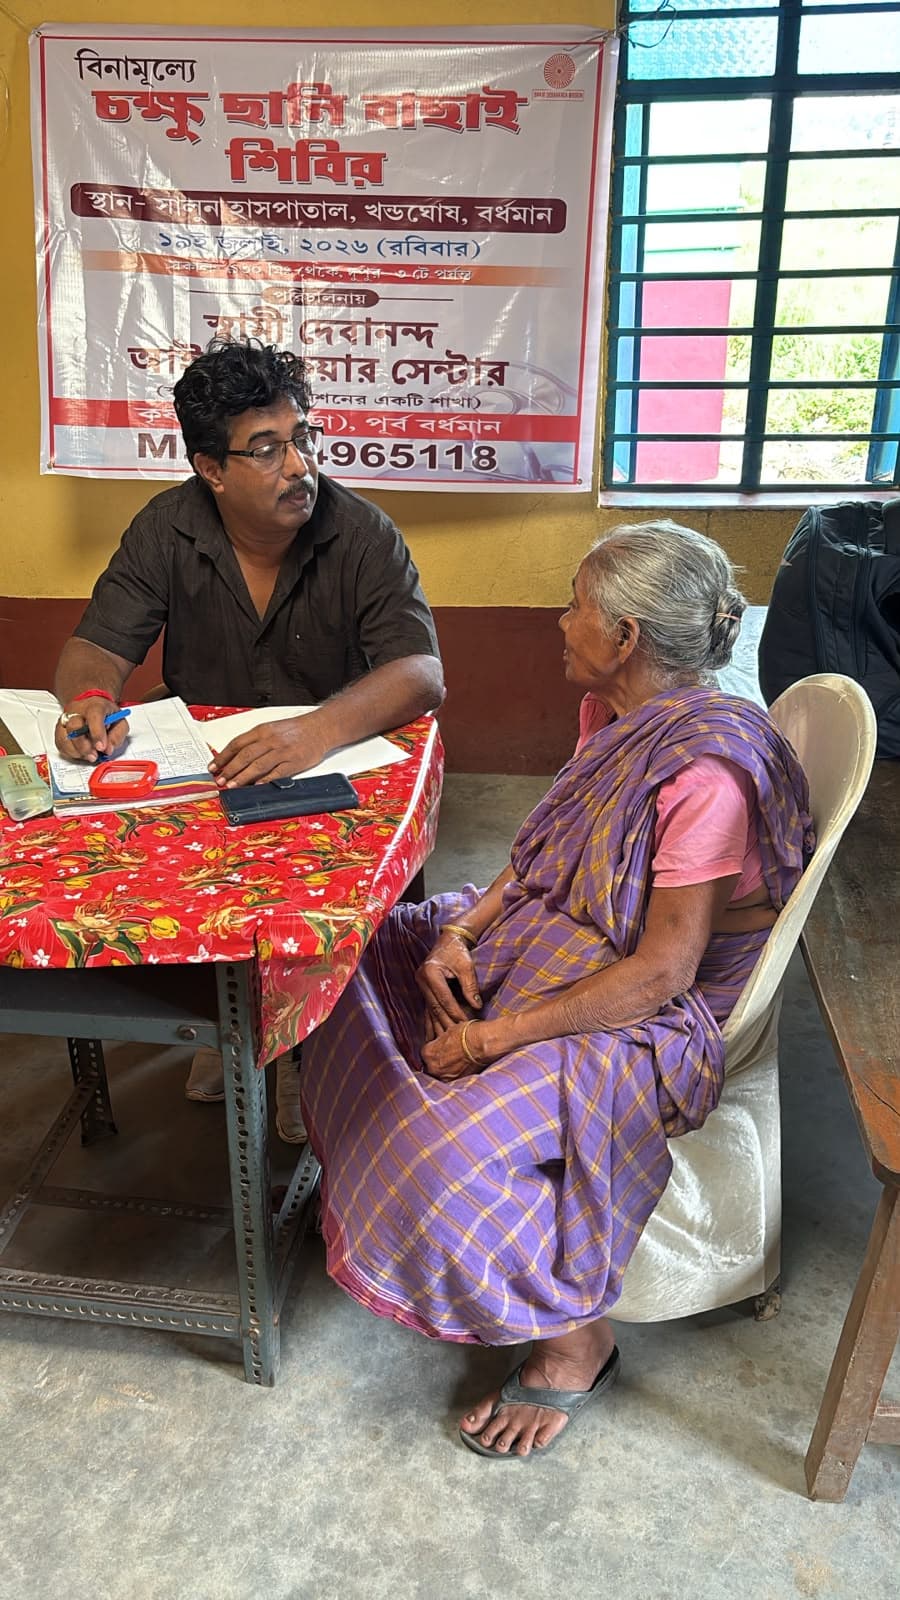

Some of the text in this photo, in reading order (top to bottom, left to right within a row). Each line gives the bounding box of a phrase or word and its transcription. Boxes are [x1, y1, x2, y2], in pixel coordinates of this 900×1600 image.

[75, 48, 197, 87] বিনামূল্যে
[91, 82, 529, 144] চক্ষু ছানি বাছাই
[224, 137, 388, 188] শিবির
[152, 196, 219, 223] সালুন
[226, 198, 356, 224] হাসপাতাল,
[365, 200, 468, 226] খন্ডঘোষ,
[474, 199, 553, 225] বর্ধমান
[159, 232, 209, 252] ১৯ই
[301, 238, 369, 255] ২০২৬
[377, 235, 481, 259] (রবিবার)
[272, 288, 367, 304] পরিচালনায়
[299, 317, 438, 349] দেবানন্দ
[391, 350, 509, 386] সেন্টার
[375, 393, 424, 407] একটি
[366, 414, 414, 436] পূর্ব
[416, 415, 501, 434] বর্ধমান
